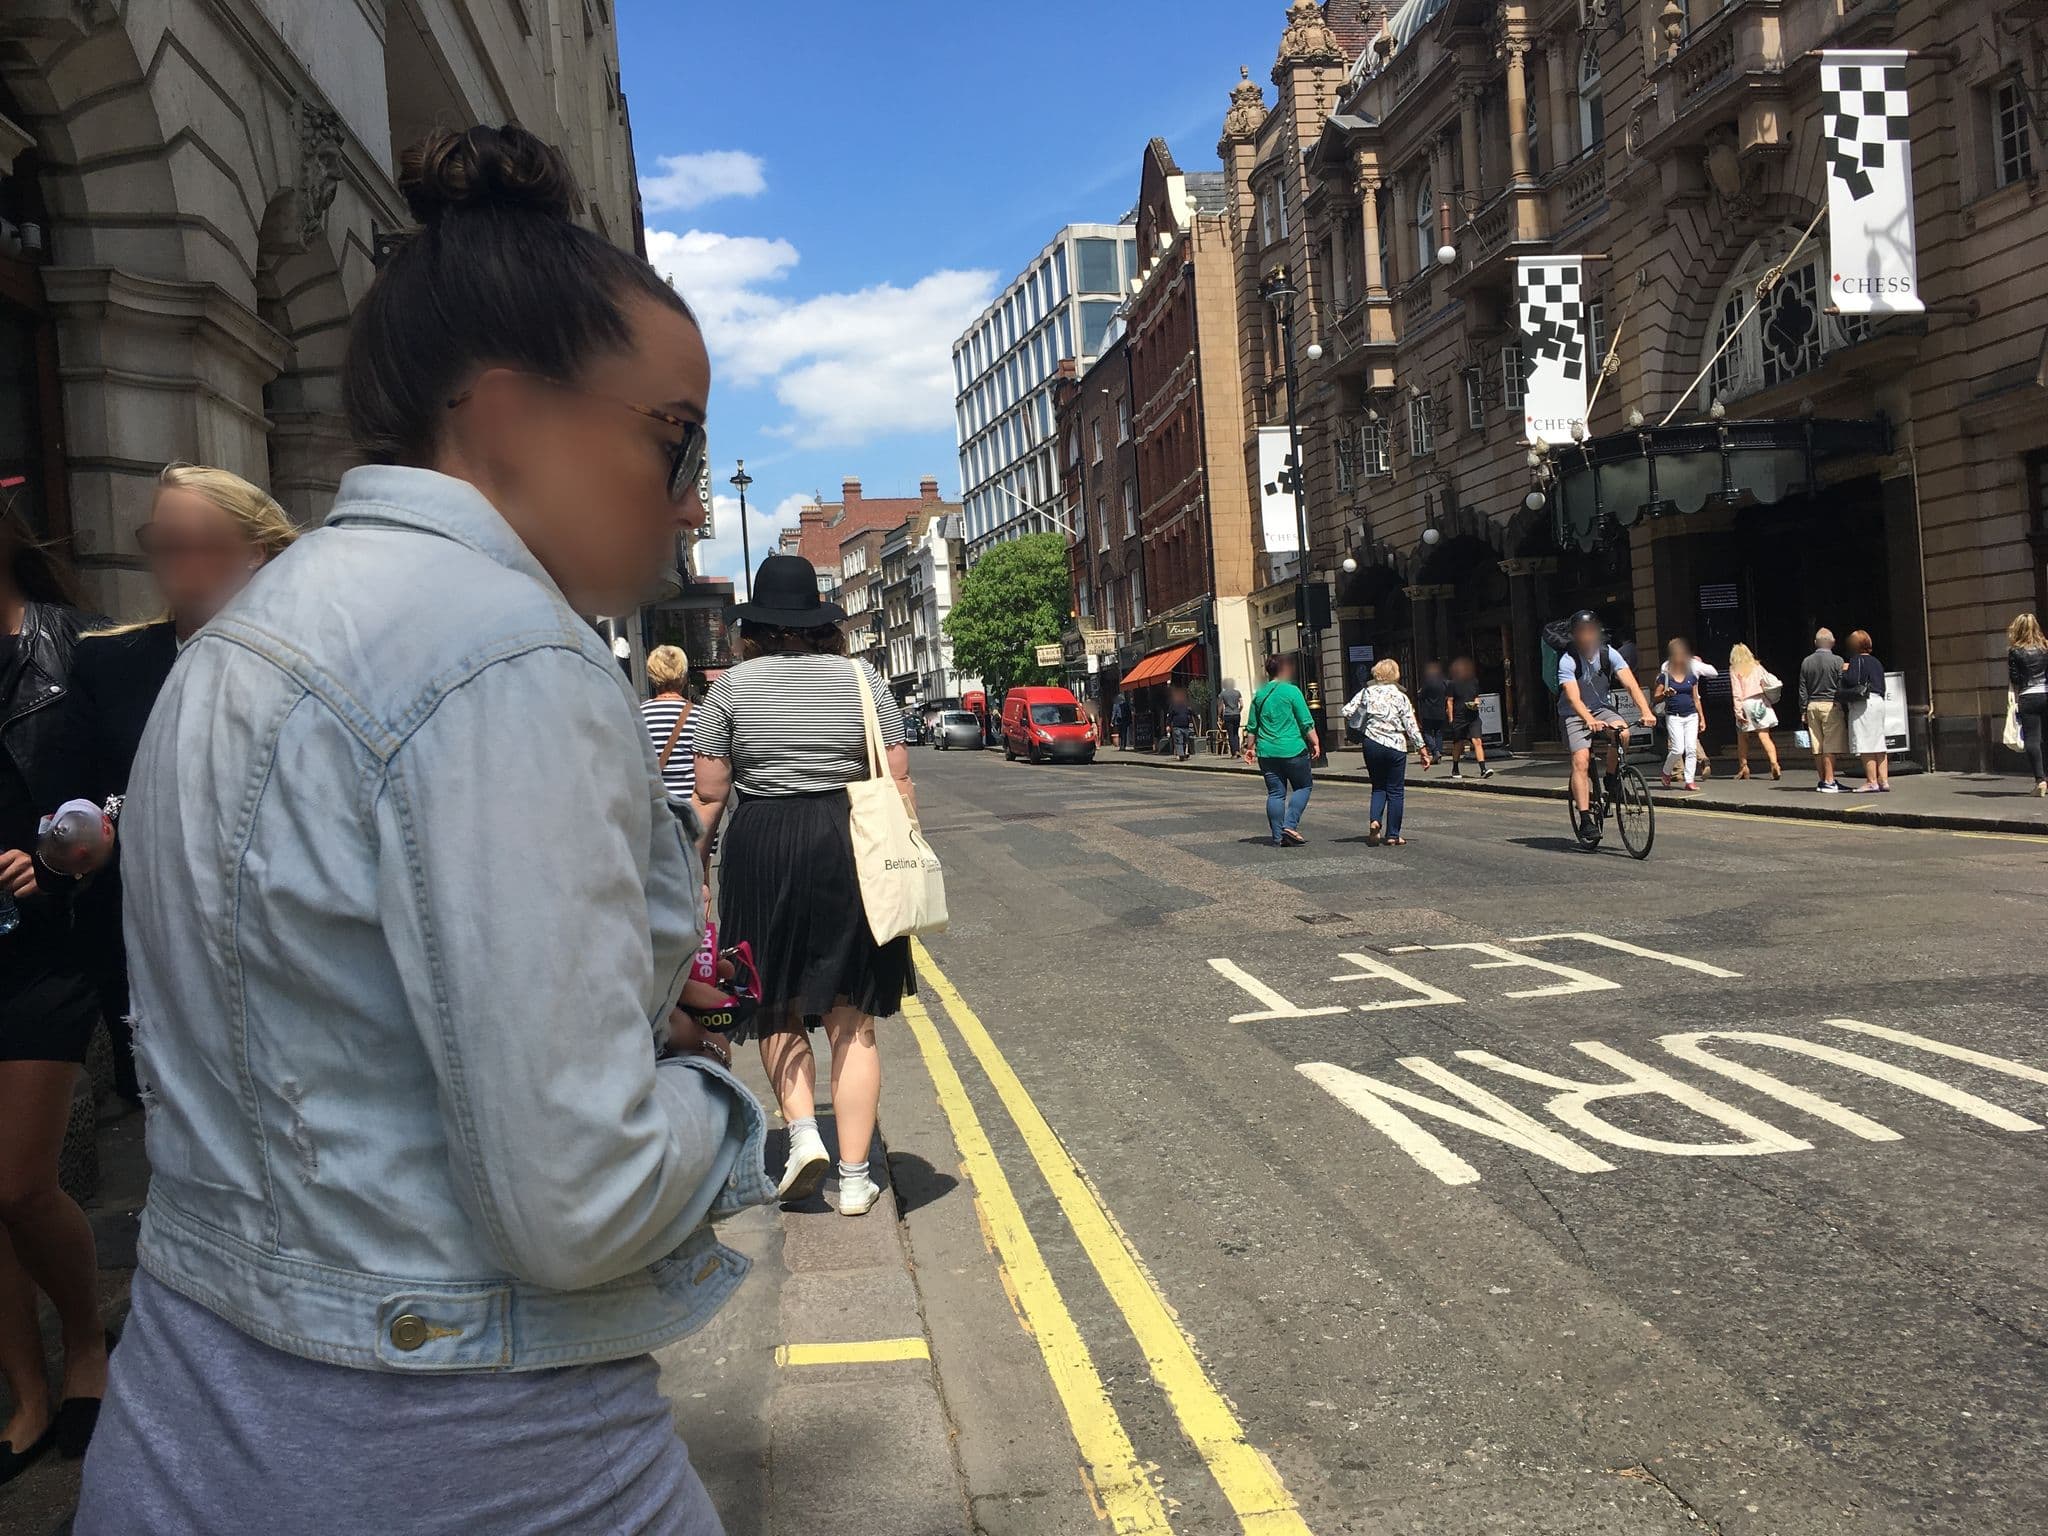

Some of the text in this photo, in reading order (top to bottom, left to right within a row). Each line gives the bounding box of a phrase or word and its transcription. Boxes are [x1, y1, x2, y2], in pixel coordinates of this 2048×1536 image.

[1842, 277, 1911, 294] CHESS
[1270, 533, 1298, 542] CHES
[1207, 932, 1743, 1024] LEFT
